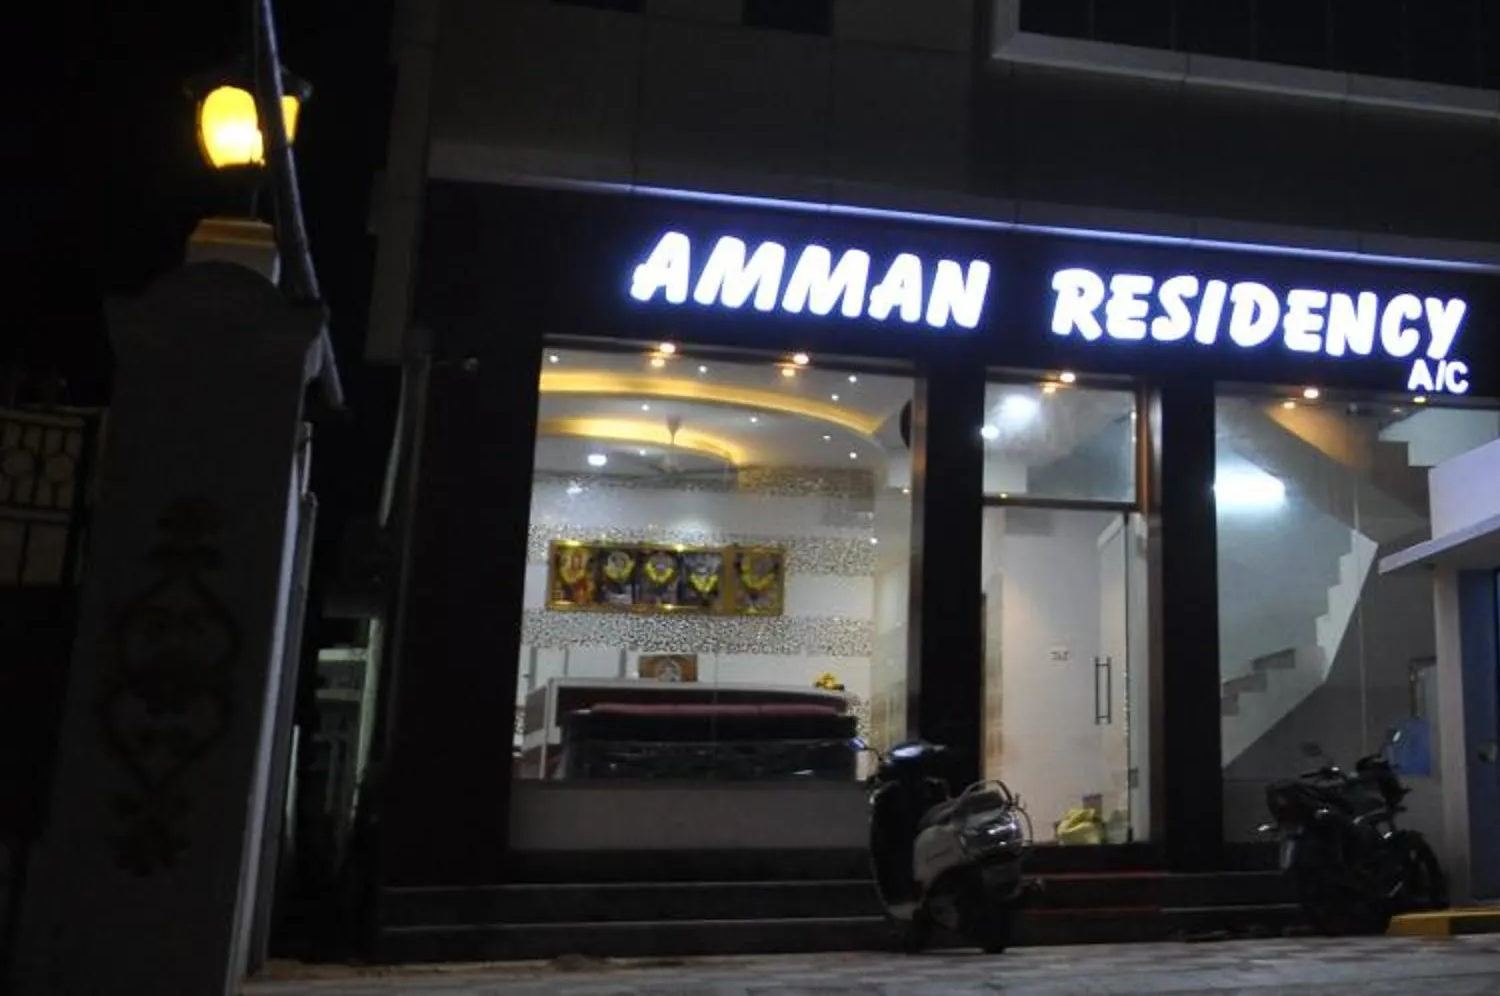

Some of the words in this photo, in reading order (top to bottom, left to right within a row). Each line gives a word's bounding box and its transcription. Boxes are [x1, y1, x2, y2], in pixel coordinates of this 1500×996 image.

[629, 230, 992, 330] AMMAN
[1050, 266, 1468, 362] RESIDENCY
[1406, 357, 1471, 395] A/C
